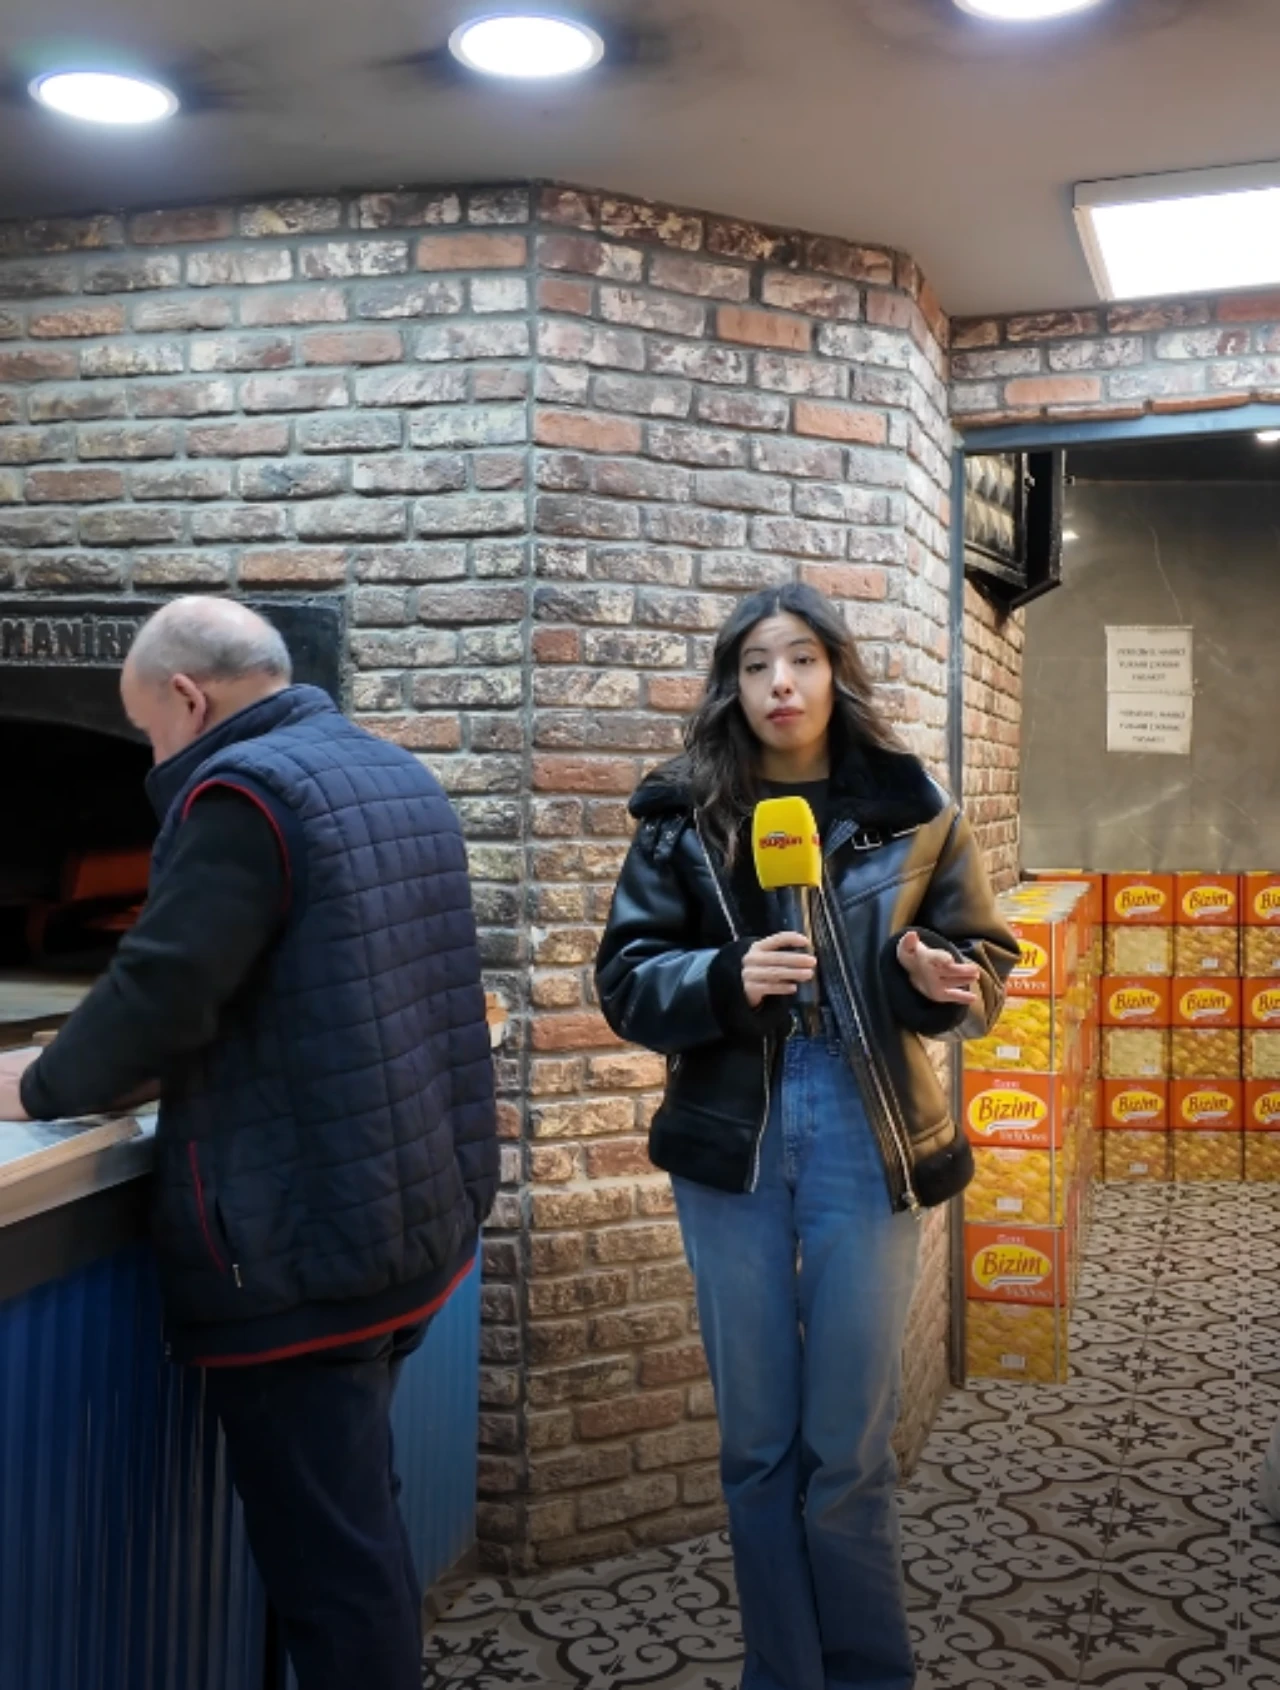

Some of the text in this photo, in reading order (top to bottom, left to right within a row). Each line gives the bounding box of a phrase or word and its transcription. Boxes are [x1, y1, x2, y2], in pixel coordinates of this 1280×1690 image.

[1121, 890, 1161, 909] Bizim
[1189, 890, 1229, 909] Bizim
[1114, 993, 1155, 1010] Bizim
[1187, 993, 1226, 1011] Bizim
[979, 1096, 1038, 1122] Bizim
[1117, 1095, 1159, 1113] Bizim
[1187, 1095, 1228, 1113] Bizim
[981, 1251, 1043, 1276] Bizim
